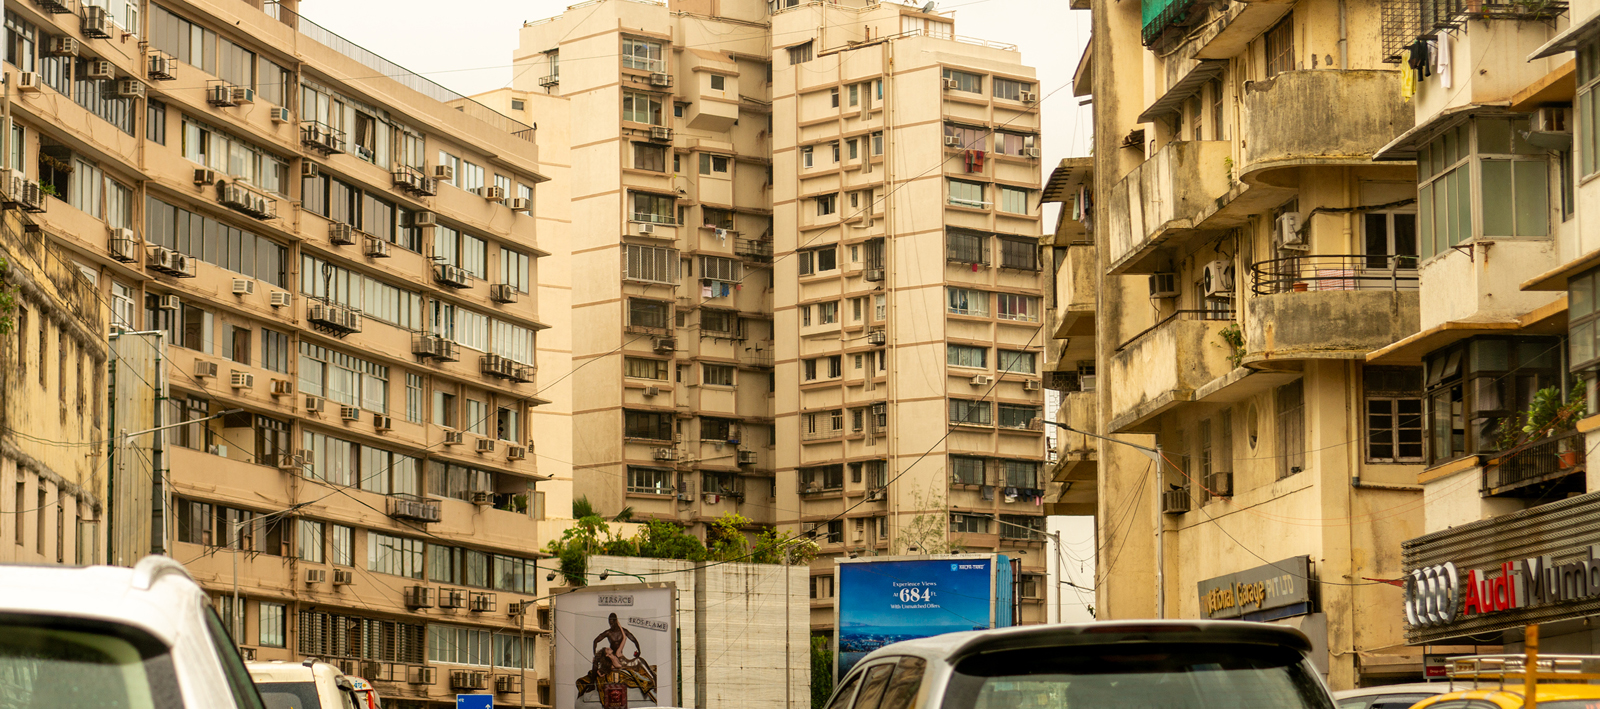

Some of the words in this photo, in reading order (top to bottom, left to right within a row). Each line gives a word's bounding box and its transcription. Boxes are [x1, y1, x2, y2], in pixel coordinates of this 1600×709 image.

[1463, 561, 1516, 615] Audi
[1521, 545, 1600, 606] Mumb
[899, 587, 931, 602] 684
[1236, 581, 1266, 608] Garage
[1266, 577, 1280, 598] PVT
[1279, 574, 1294, 596] LTD
[599, 596, 632, 604] VERSACE
[645, 620, 667, 630] FLAME
